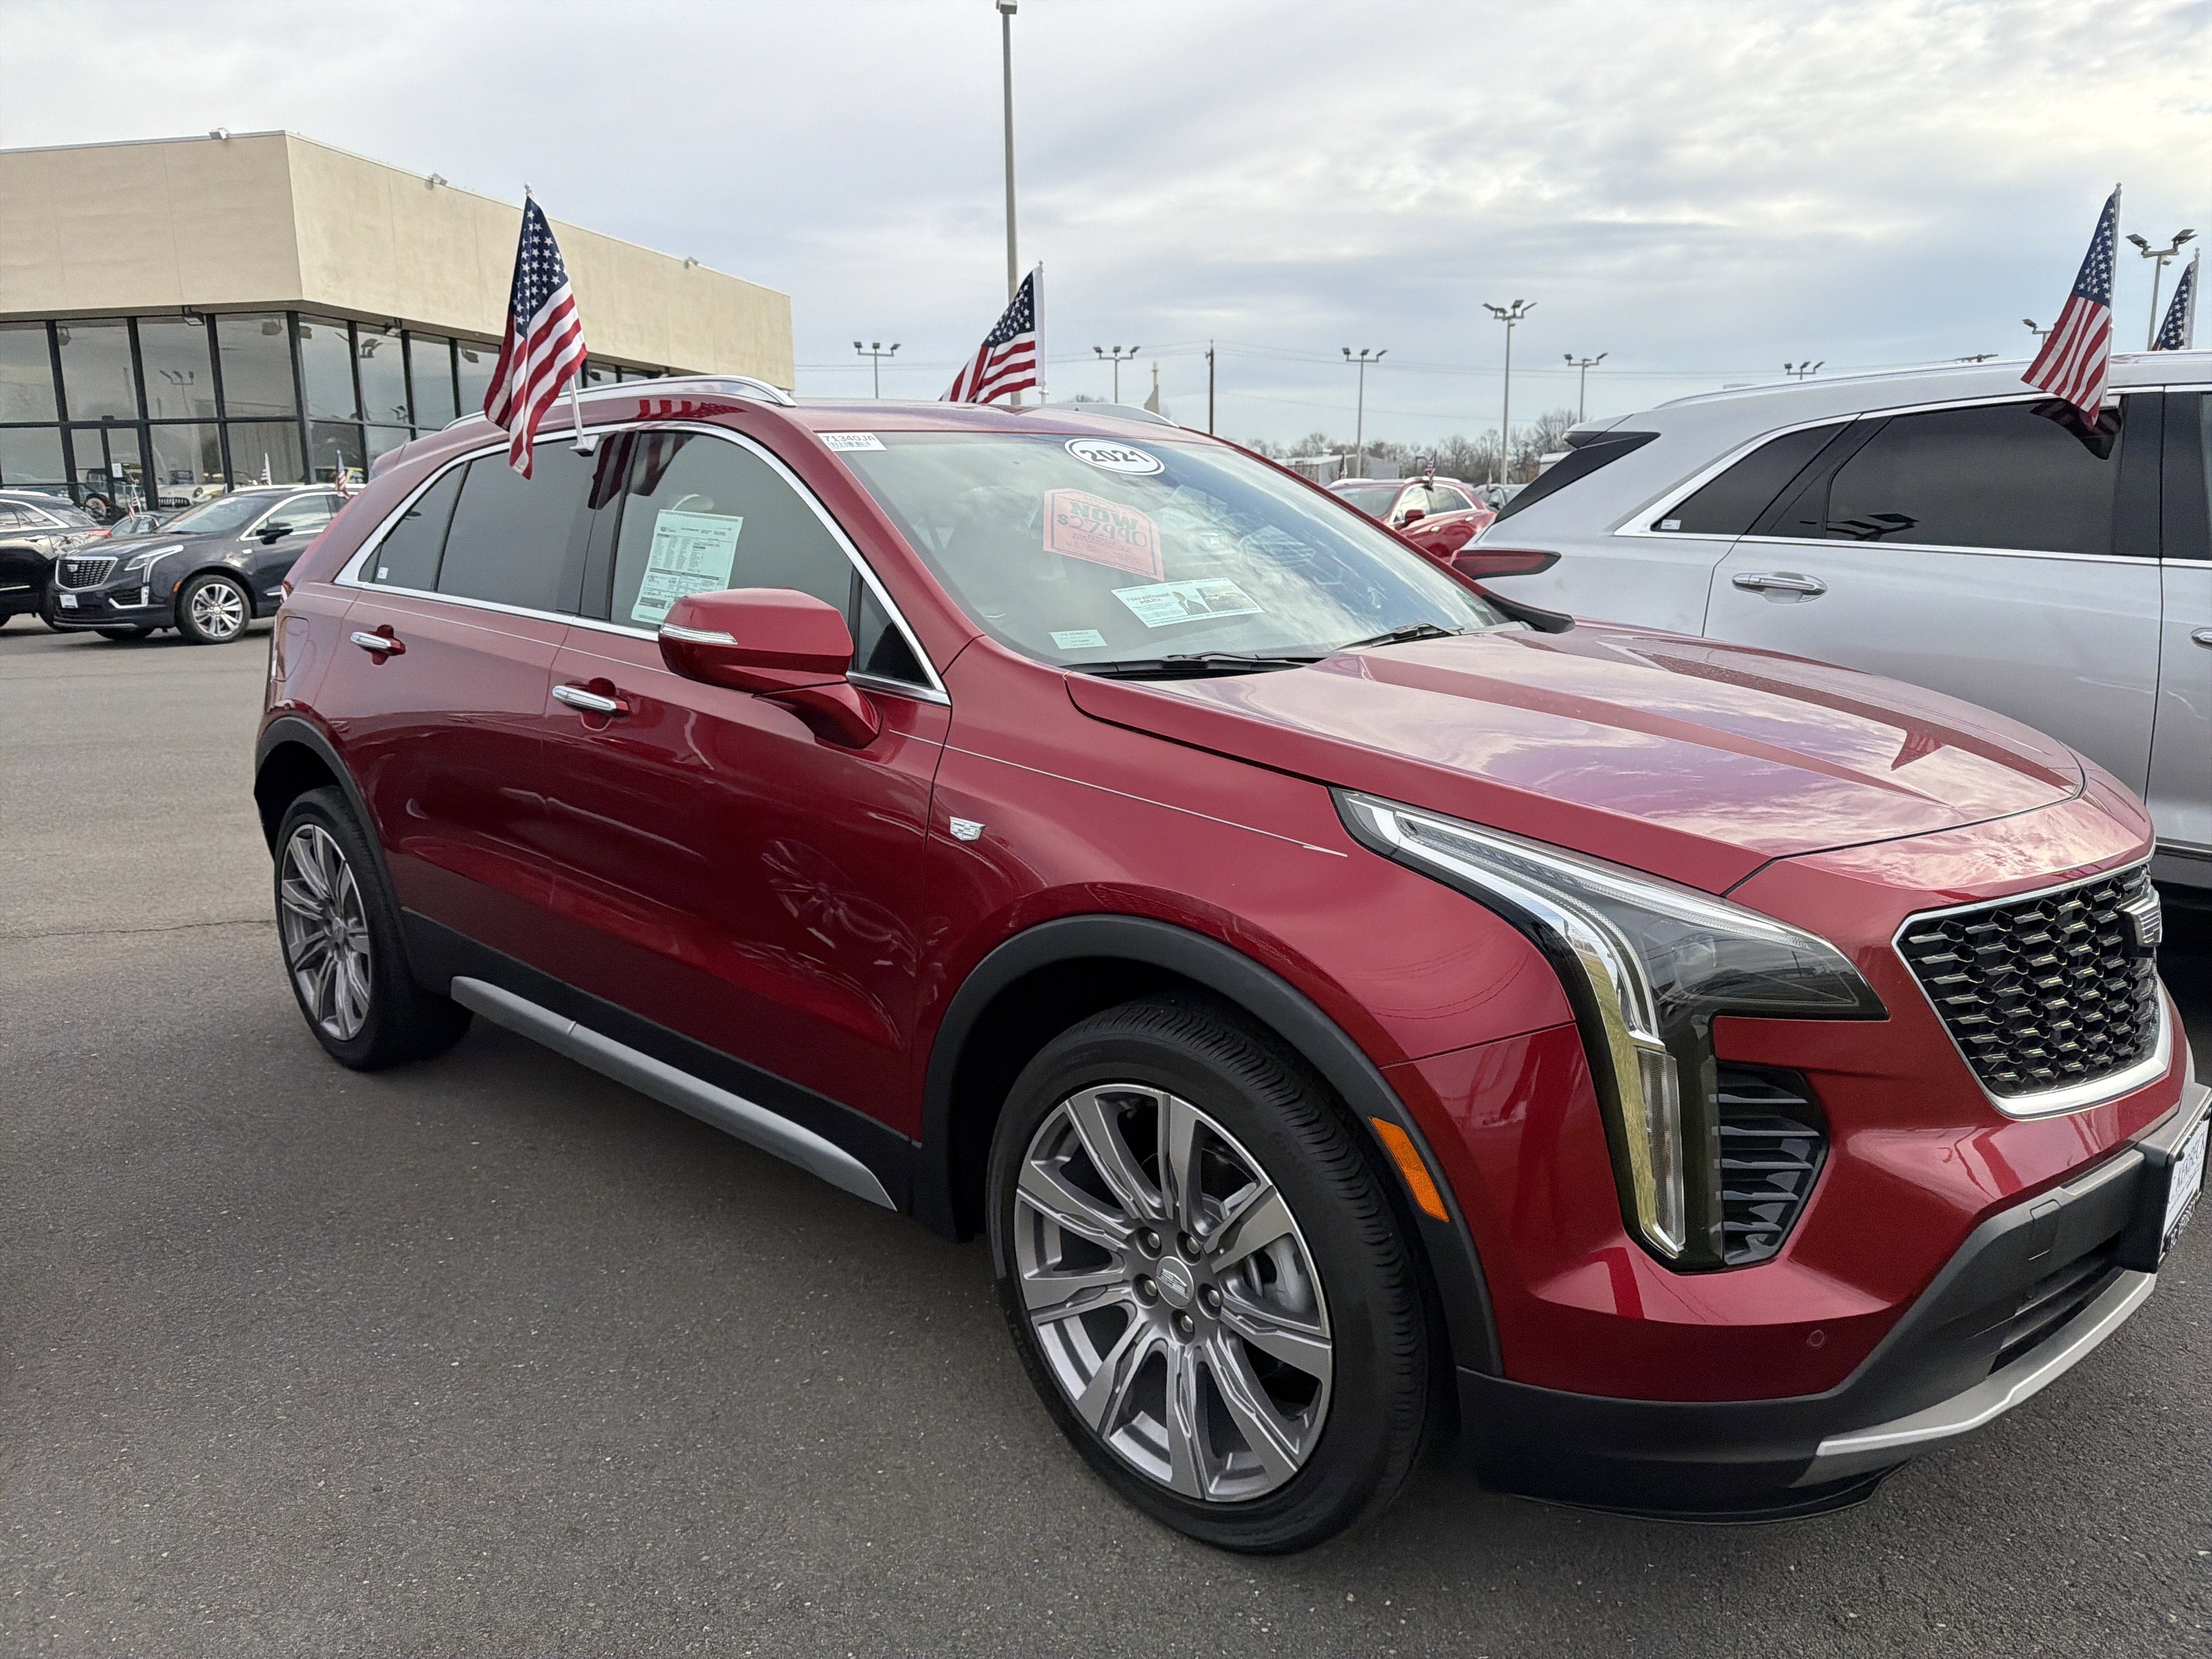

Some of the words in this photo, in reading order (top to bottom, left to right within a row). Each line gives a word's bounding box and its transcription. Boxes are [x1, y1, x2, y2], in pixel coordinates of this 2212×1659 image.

[1079, 449, 1150, 462] 2021
[1070, 501, 1138, 530] NOW
[1057, 514, 1147, 547] $27990
